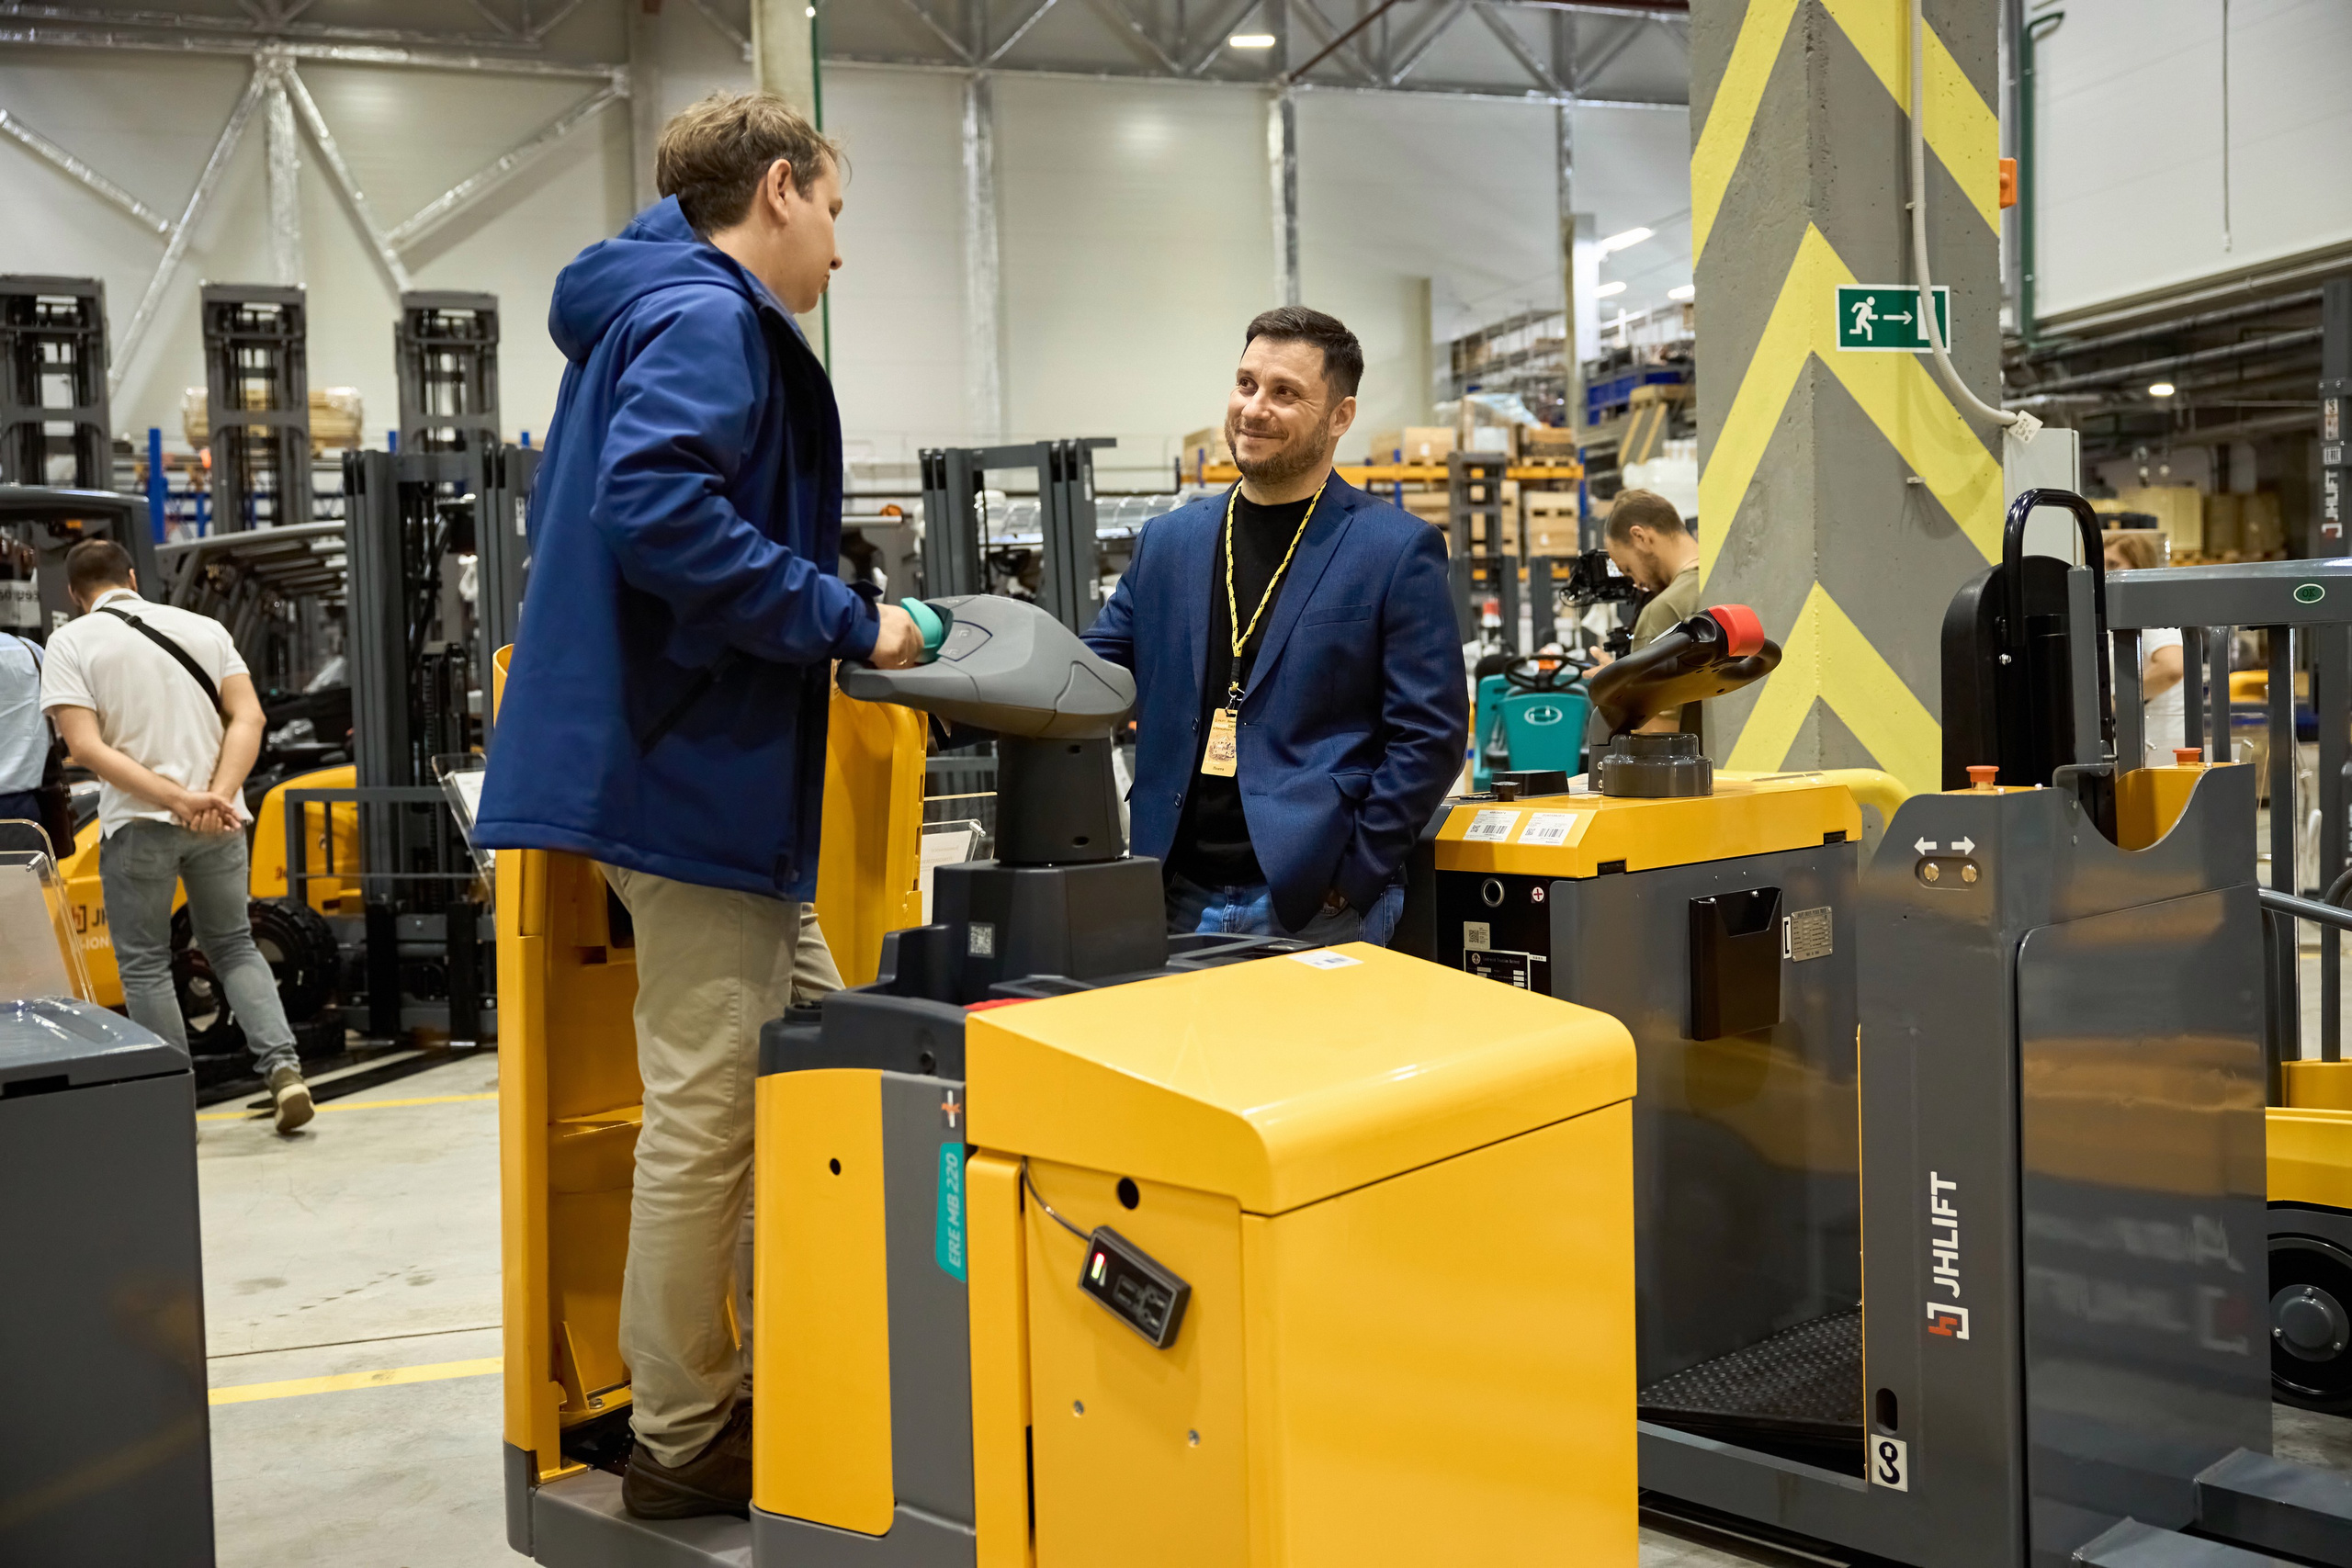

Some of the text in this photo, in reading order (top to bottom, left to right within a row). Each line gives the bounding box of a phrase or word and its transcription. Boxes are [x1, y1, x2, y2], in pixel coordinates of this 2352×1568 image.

[2324, 469, 2339, 521] JHLIFT
[2301, 588, 2315, 598] OK
[945, 1152, 961, 1269] ERE MB 220
[1930, 1171, 1961, 1299] JHLIFT
